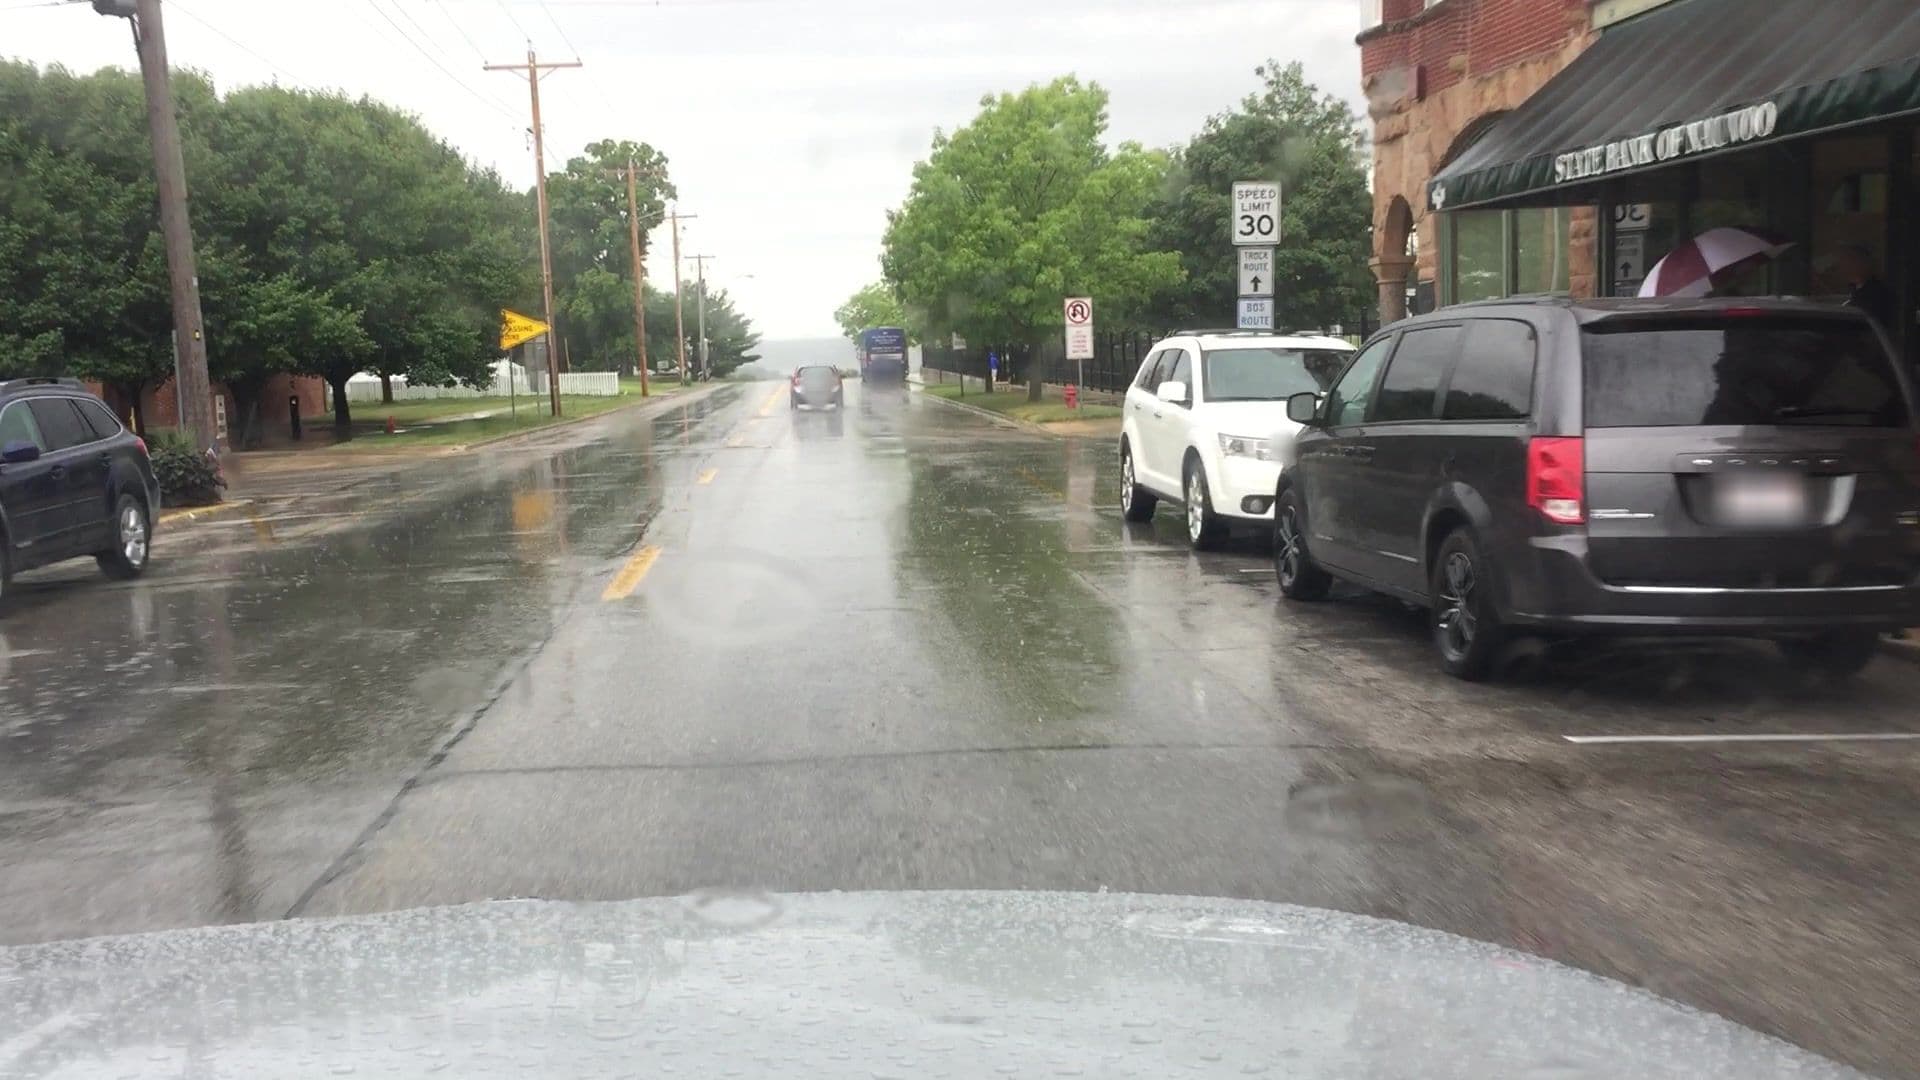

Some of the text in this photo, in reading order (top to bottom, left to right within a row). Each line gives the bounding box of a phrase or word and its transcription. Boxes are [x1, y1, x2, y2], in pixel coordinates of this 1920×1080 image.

[1555, 145, 1605, 183] STATE
[1605, 133, 1656, 172] BANK
[1656, 124, 1687, 161] OF
[1237, 189, 1276, 200] SPEED
[1241, 202, 1271, 212] LIMIT
[1239, 214, 1274, 236] 30
[1244, 263, 1269, 272] ROUTE
[1241, 316, 1270, 326] ROUTE
